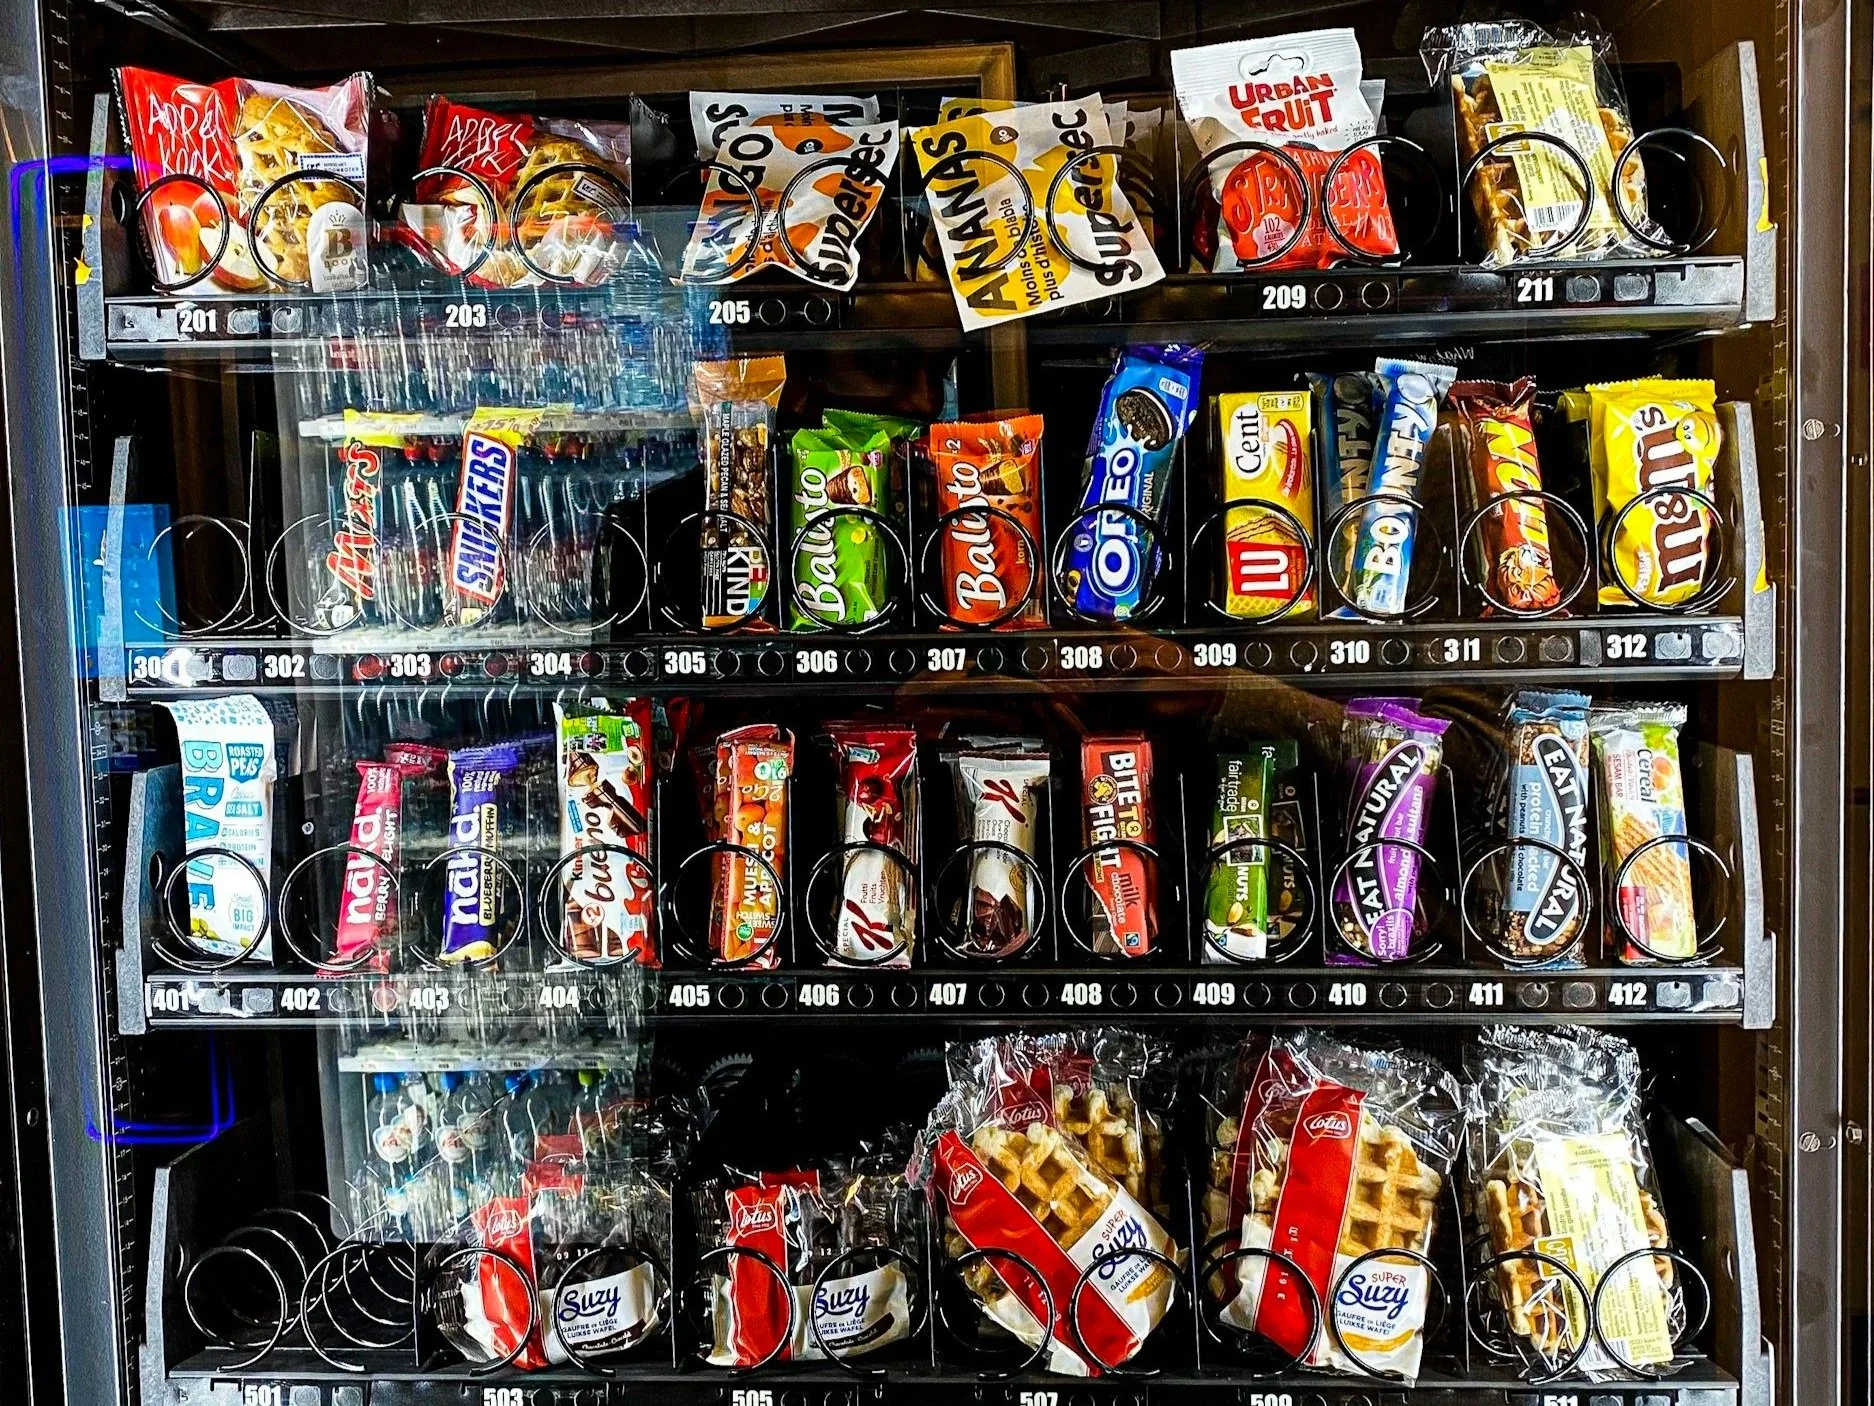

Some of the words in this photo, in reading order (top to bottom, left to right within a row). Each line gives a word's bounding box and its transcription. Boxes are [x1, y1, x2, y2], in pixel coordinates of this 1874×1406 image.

[1229, 73, 1334, 109] URBAN
[1051, 107, 1143, 287] supersec
[921, 130, 1018, 312] ANANAS
[998, 197, 1022, 242] blabla
[1263, 216, 1282, 234] 102
[1024, 261, 1044, 307] Moins
[1041, 266, 1064, 302] plus
[1517, 278, 1553, 302] 211
[1262, 285, 1306, 309] 209
[180, 309, 218, 333] 201
[445, 304, 487, 328] 203
[709, 300, 751, 324] 205
[720, 438, 732, 466] GLAZED
[1235, 410, 1262, 474] Cent
[719, 467, 732, 491] PECAN
[1139, 471, 1154, 515] RIGINAL
[1098, 448, 1136, 587] OREO
[1015, 539, 1026, 565] korn
[726, 546, 751, 616] KIND
[1240, 550, 1290, 592] LU
[1060, 645, 1103, 669] 308
[1193, 643, 1237, 667] 309
[1330, 641, 1370, 664] 310
[1444, 639, 1480, 662] 311
[1606, 634, 1647, 658] 312
[264, 654, 306, 678] 302
[390, 653, 431, 677] 303
[530, 651, 572, 676] 304
[664, 651, 706, 675] 305
[796, 650, 838, 673] 306
[927, 648, 966, 671] 307
[228, 745, 264, 758] ROASTED
[230, 757, 260, 777] PEAS
[1544, 748, 1578, 797] EAT
[1612, 753, 1622, 779] SESAM
[461, 770, 475, 794] 100%
[1109, 752, 1143, 806] BITE
[1615, 779, 1624, 798] BAR
[235, 802, 260, 815] SALT
[978, 779, 1029, 824] K
[1353, 750, 1420, 868] NATURAL
[1529, 781, 1542, 836] protein
[182, 740, 225, 911] BRAVE
[485, 806, 496, 848] MUFFIN
[747, 821, 762, 836] &
[1518, 801, 1527, 836] peanuts
[227, 828, 260, 838] CALORIES
[1393, 847, 1411, 902] almond
[1407, 784, 1424, 834] sultana
[584, 811, 616, 903] bueno
[1527, 842, 1542, 893] acked
[1533, 802, 1588, 932] NATURAL
[1236, 864, 1249, 902] NUTS
[1515, 853, 1524, 892] chocolate
[374, 874, 391, 922] BERRY
[481, 853, 496, 921] BLUEBERRY
[860, 883, 868, 904] Frutti
[868, 883, 877, 905] Fruits
[877, 870, 886, 904] Vruchten
[1110, 871, 1126, 924] chocolate
[1117, 872, 1142, 907] milk
[232, 923, 255, 932] IMPACT
[233, 909, 254, 922] BIG
[735, 911, 771, 921] SWITCH
[844, 898, 894, 951] K
[153, 988, 191, 1011] 401
[281, 987, 320, 1011] 402
[408, 987, 450, 1011] 403
[540, 985, 581, 1008] 404
[668, 985, 711, 1007] 405
[798, 984, 840, 1006] 406
[929, 983, 968, 1006] 407
[1061, 983, 1102, 1006] 408
[1193, 982, 1236, 1005] 409
[1328, 983, 1367, 1006] 410
[1469, 982, 1504, 1005] 411
[1608, 982, 1647, 1005] 412
[1309, 1115, 1349, 1132] Lotus
[1101, 1208, 1127, 1241] SUPER
[1092, 1215, 1148, 1281] Suzy
[1109, 1266, 1133, 1292] GAUFRE
[1118, 1271, 1140, 1293] LUIKSE
[1371, 1272, 1408, 1288] SUPER
[559, 1286, 621, 1322] Suzy
[814, 1284, 870, 1318] Suzy
[1338, 1274, 1409, 1319] Suzy
[561, 1322, 590, 1334] GAUFRE
[566, 1328, 592, 1339] LUIKSE
[592, 1324, 618, 1335] WAFEL
[839, 1325, 864, 1334] WAFEL
[1336, 1309, 1367, 1323] GAUFRE
[1375, 1318, 1397, 1330] LIÈGE
[1337, 1317, 1366, 1330] LUIKSE
[245, 1385, 280, 1406] 501
[483, 1388, 523, 1406] 503
